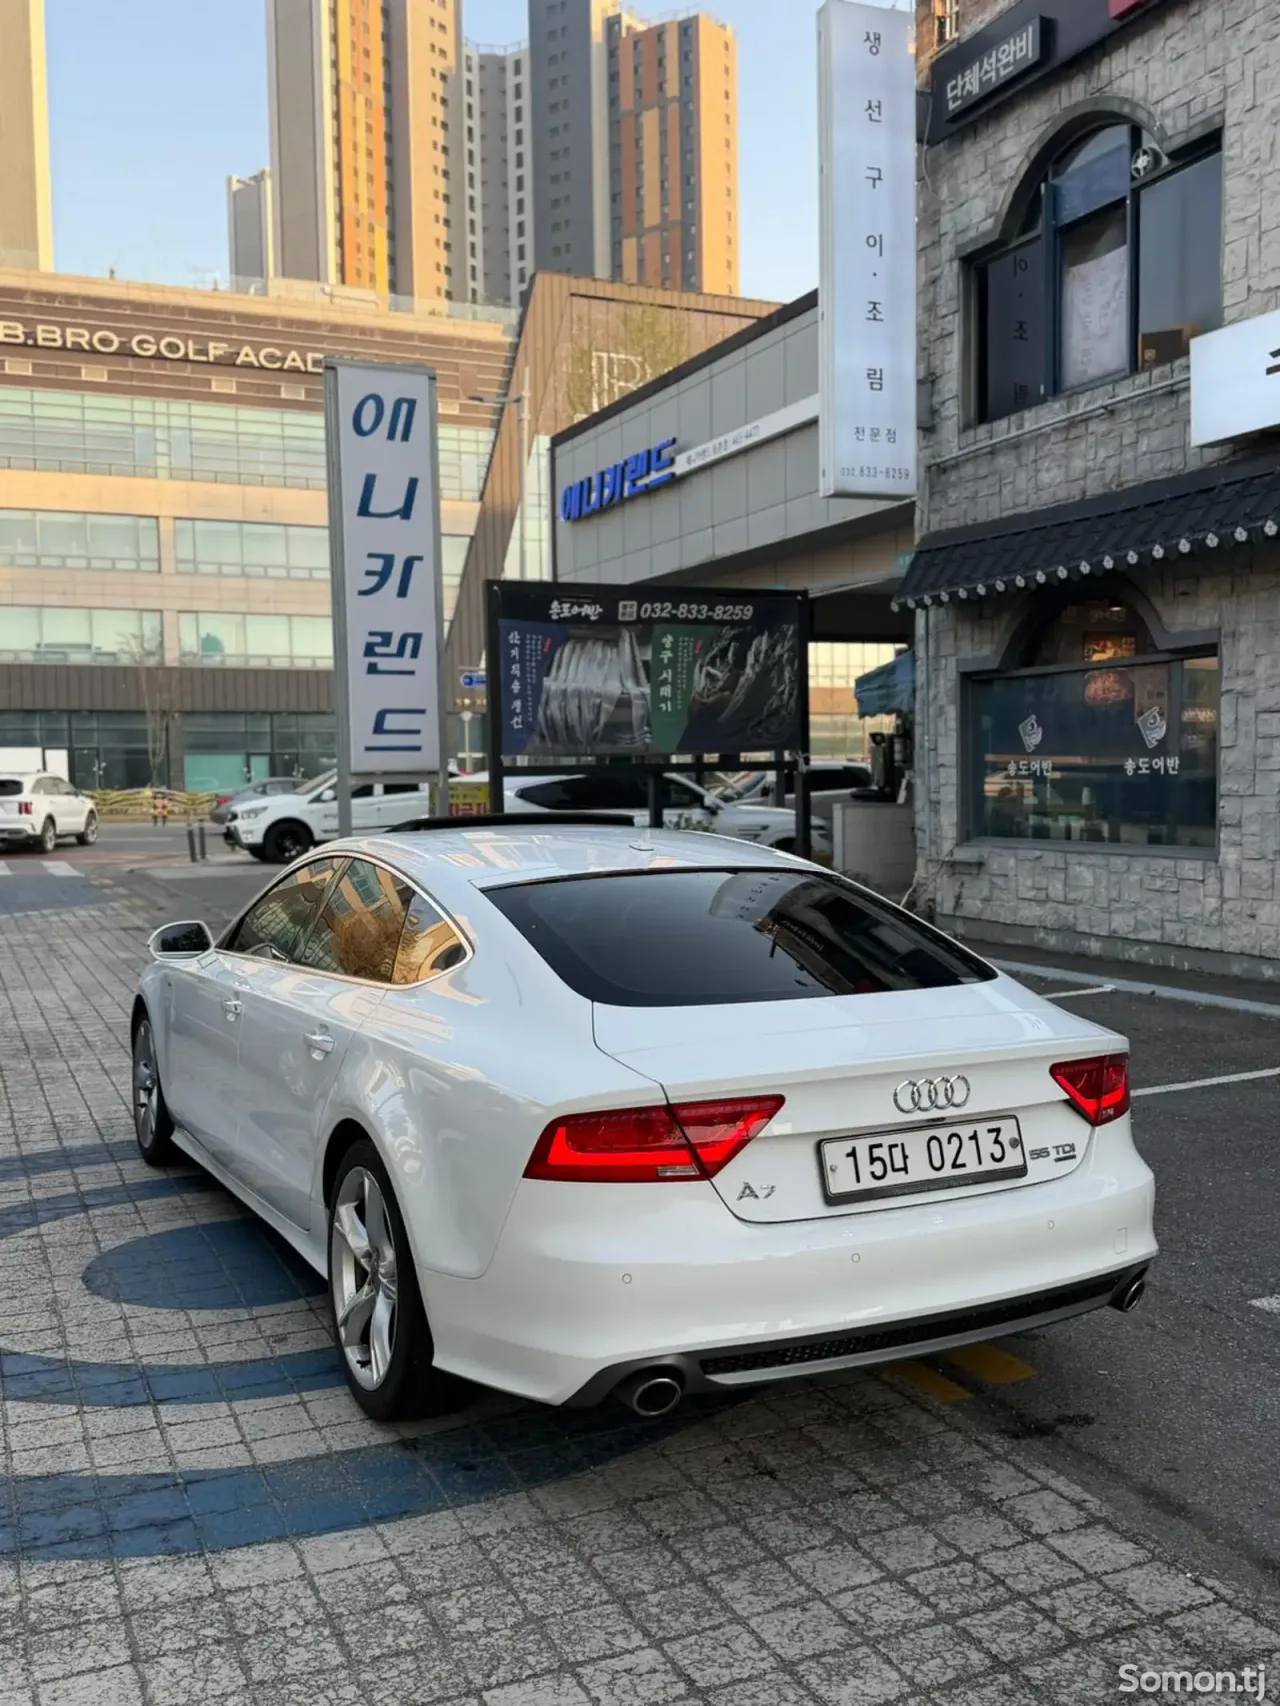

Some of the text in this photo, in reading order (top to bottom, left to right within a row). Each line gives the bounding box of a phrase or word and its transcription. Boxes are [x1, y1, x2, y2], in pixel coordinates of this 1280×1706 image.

[946, 25, 1033, 111] 단체석완비
[131, 334, 228, 361] GOLF
[853, 426, 897, 444] 전문점
[560, 437, 677, 522] 애니카랜드
[352, 393, 426, 752] 애니카랜드
[640, 602, 753, 620] 032-833-8259
[1007, 760, 1053, 776] 송도어반
[1124, 756, 1180, 776] 송도어반
[845, 1127, 1005, 1184] 15다 0213
[1029, 1143, 1076, 1160] 55 TDI
[736, 1181, 776, 1201] A7
